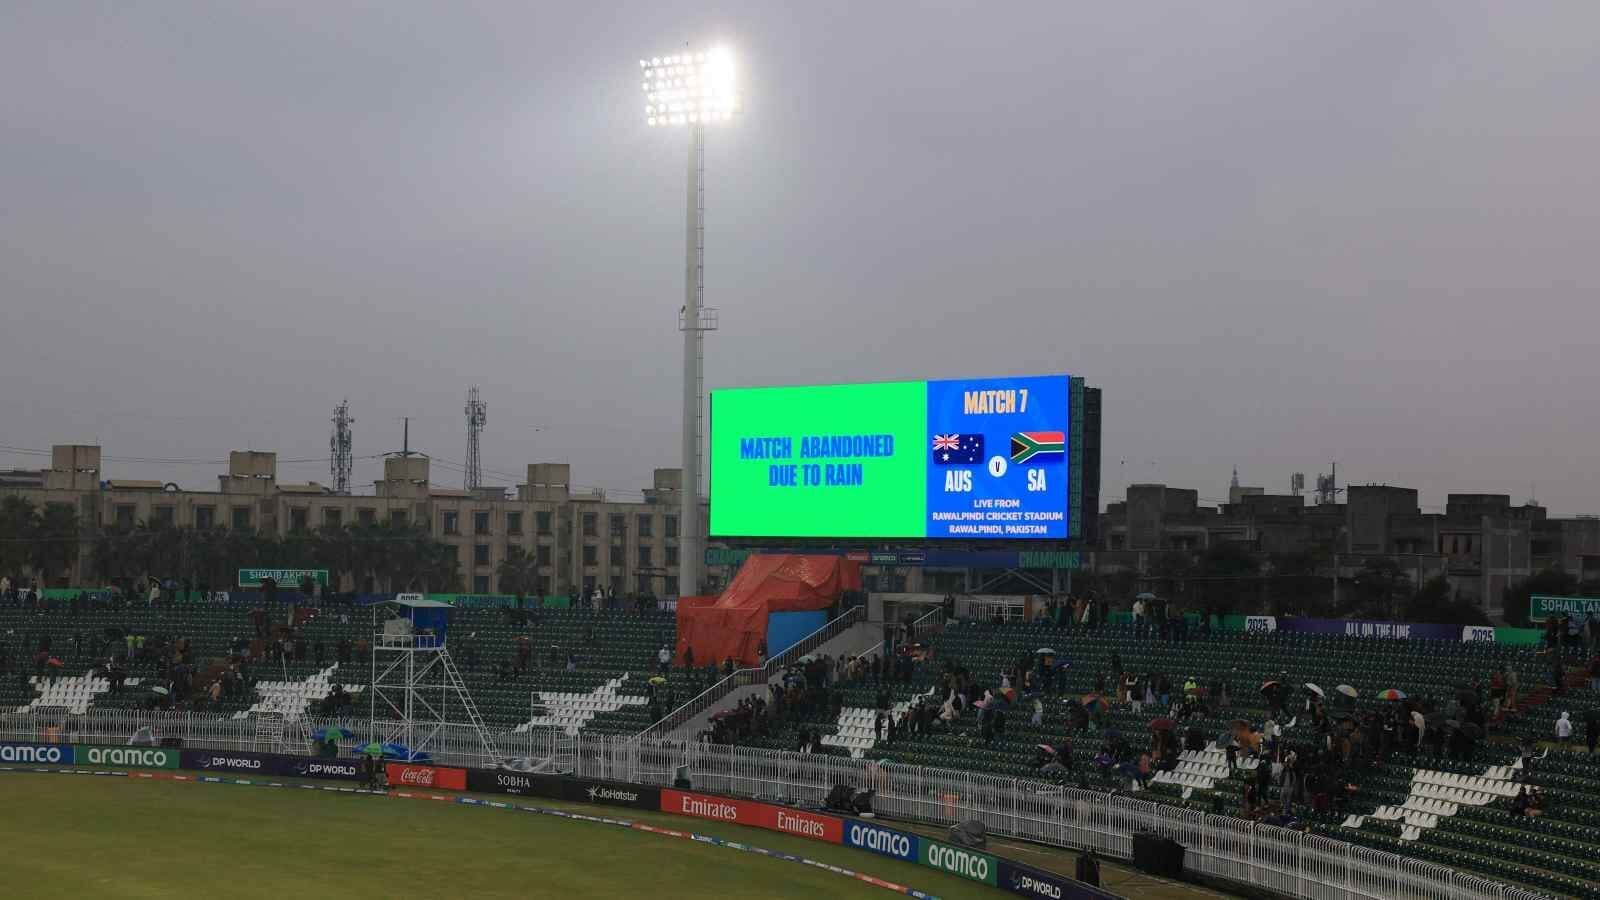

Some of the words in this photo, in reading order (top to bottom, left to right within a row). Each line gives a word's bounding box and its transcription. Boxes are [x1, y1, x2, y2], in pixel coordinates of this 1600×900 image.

[964, 389, 1016, 414] MATCH
[1019, 389, 1028, 413] 7
[740, 436, 792, 459] MATCH
[800, 434, 894, 458] ABANDONED
[769, 464, 797, 487] DUE
[802, 464, 820, 486] TO
[825, 463, 862, 486] RAIN
[945, 470, 972, 492] AUS
[1027, 469, 1046, 491] SA
[974, 499, 992, 508] LIVE
[994, 499, 1020, 508] FROM
[932, 512, 984, 521] RAWALPINDI
[986, 512, 1022, 521] CRICKET
[1024, 512, 1063, 521] STADIUM
[949, 525, 1004, 535] RAWALPINDI,
[1005, 525, 1047, 534] PAKISTAN
[1018, 552, 1080, 569] CHAMPIONS
[1540, 599, 1579, 613] SOHAIL
[1375, 624, 1391, 638] THE
[0, 746, 61, 763] amco
[87, 747, 167, 766] aramco
[212, 757, 226, 766] DP
[227, 758, 261, 769] WORLD
[309, 764, 322, 774] DP
[323, 765, 356, 776] WORLD
[497, 774, 530, 788] SOBHA
[599, 788, 638, 801] JioHotstar
[682, 796, 737, 821] Emirates
[777, 811, 824, 837] Emirates
[849, 824, 909, 857] aramco
[928, 843, 988, 880] aramco
[1021, 875, 1034, 889] DP
[1034, 879, 1061, 899] WORLD
